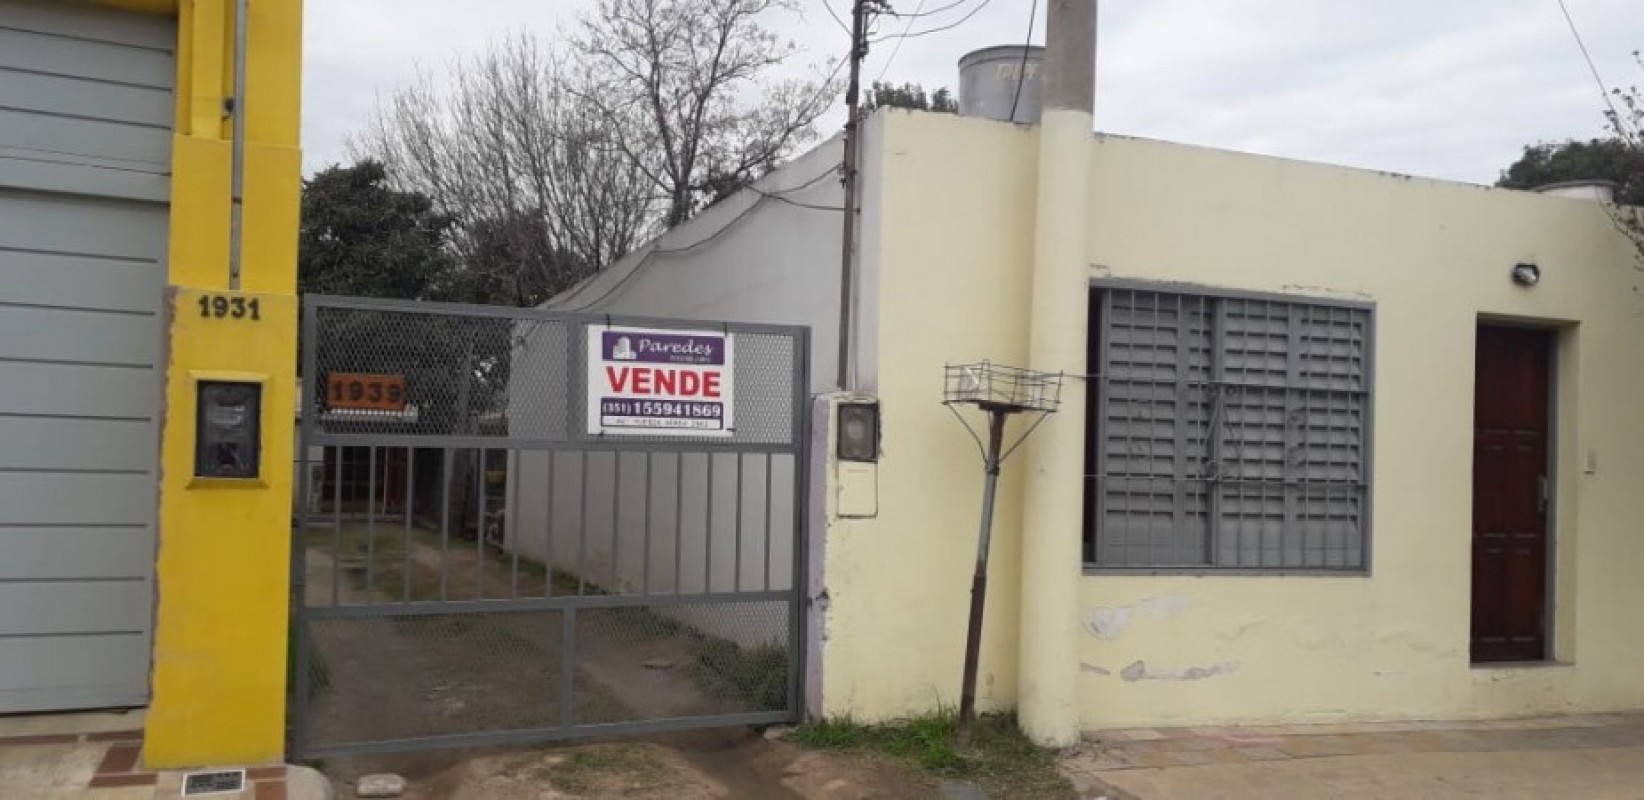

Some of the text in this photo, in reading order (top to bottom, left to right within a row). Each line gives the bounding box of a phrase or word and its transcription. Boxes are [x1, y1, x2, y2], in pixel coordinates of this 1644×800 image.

[198, 294, 260, 320] 1931
[639, 338, 712, 356] Paredes
[332, 381, 402, 404] 1939
[606, 365, 721, 397] VENDE
